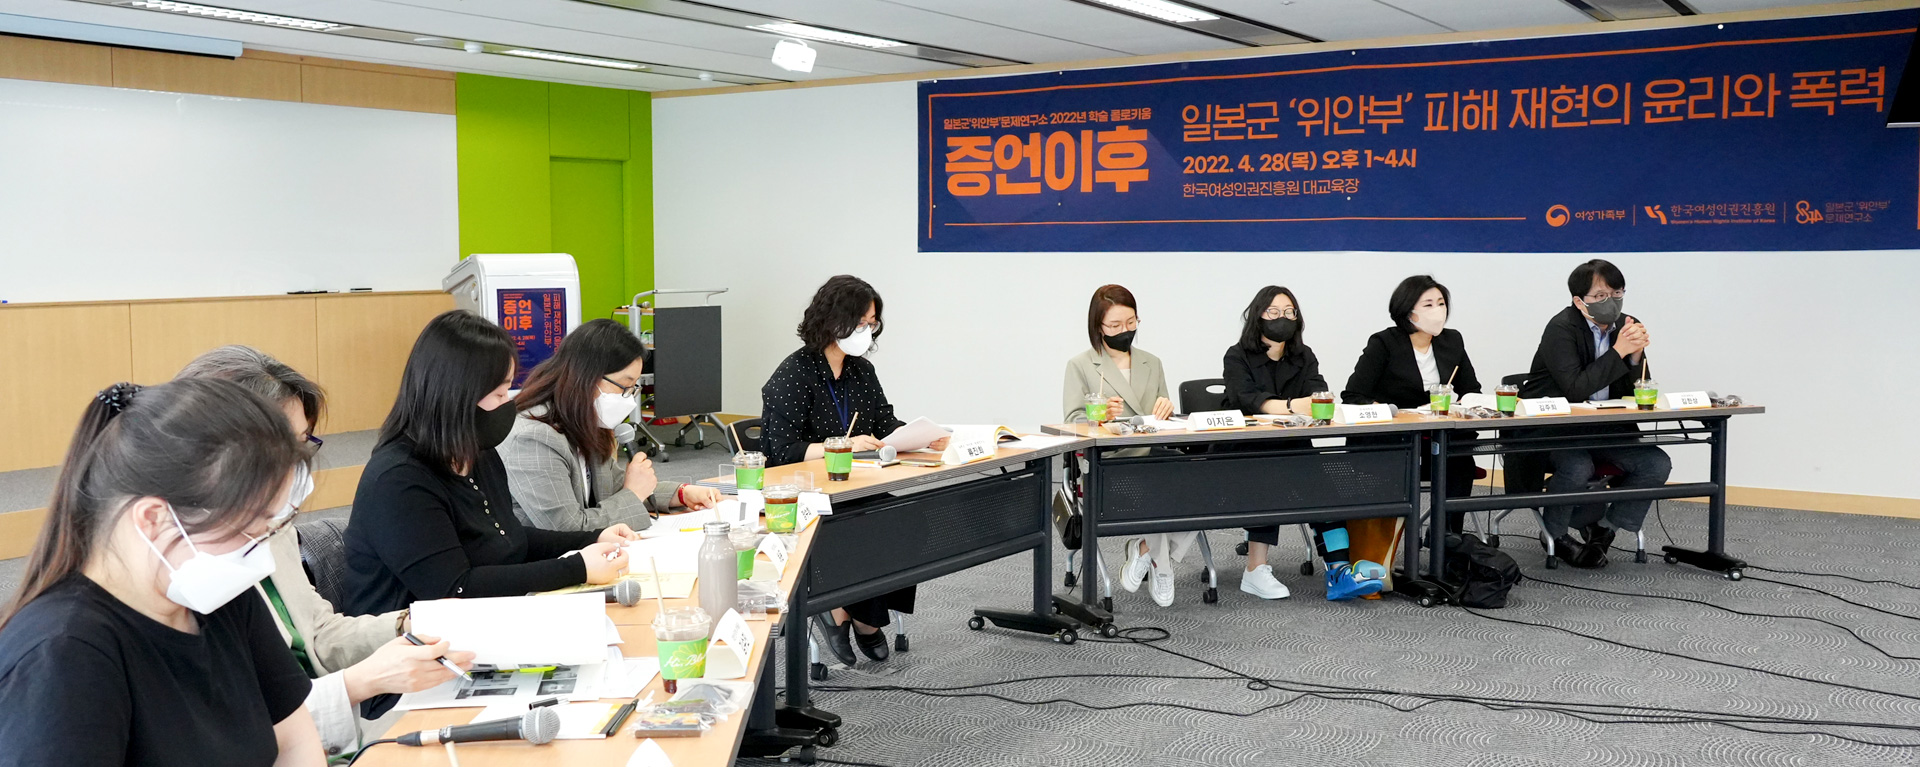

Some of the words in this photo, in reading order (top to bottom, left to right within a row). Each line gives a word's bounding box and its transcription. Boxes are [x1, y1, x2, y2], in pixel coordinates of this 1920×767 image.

[1182, 102, 1280, 142] 일본군
[1290, 93, 1413, 137] ‘위안부’
[1424, 89, 1498, 132] 피해
[1509, 83, 1631, 128] 재현의
[1643, 73, 1781, 123] 윤리와
[1790, 66, 1885, 115] 폭력
[1050, 112, 1087, 124] 2022년
[1089, 110, 1109, 122] 학술
[1111, 108, 1152, 121] 콜로키움
[945, 125, 1150, 197] 증언이후
[1184, 155, 1234, 174] 2022.
[1238, 155, 1255, 172] 4.
[1260, 151, 1317, 171] 28(목)
[1323, 149, 1359, 169] 오후
[1365, 149, 1417, 168] 1~4시
[1184, 181, 1300, 198] 한국여성인권진흥원
[1303, 178, 1360, 194] 대교육장
[1670, 203, 1776, 217] 한국여성인권진흥원
[1825, 201, 1854, 213] 일본군
[1575, 210, 1626, 221] 여성가족부
[1825, 213, 1873, 224] 문제연구소
[503, 299, 532, 315] 증언
[503, 315, 532, 330] 이후
[1206, 416, 1235, 427] 이지은
